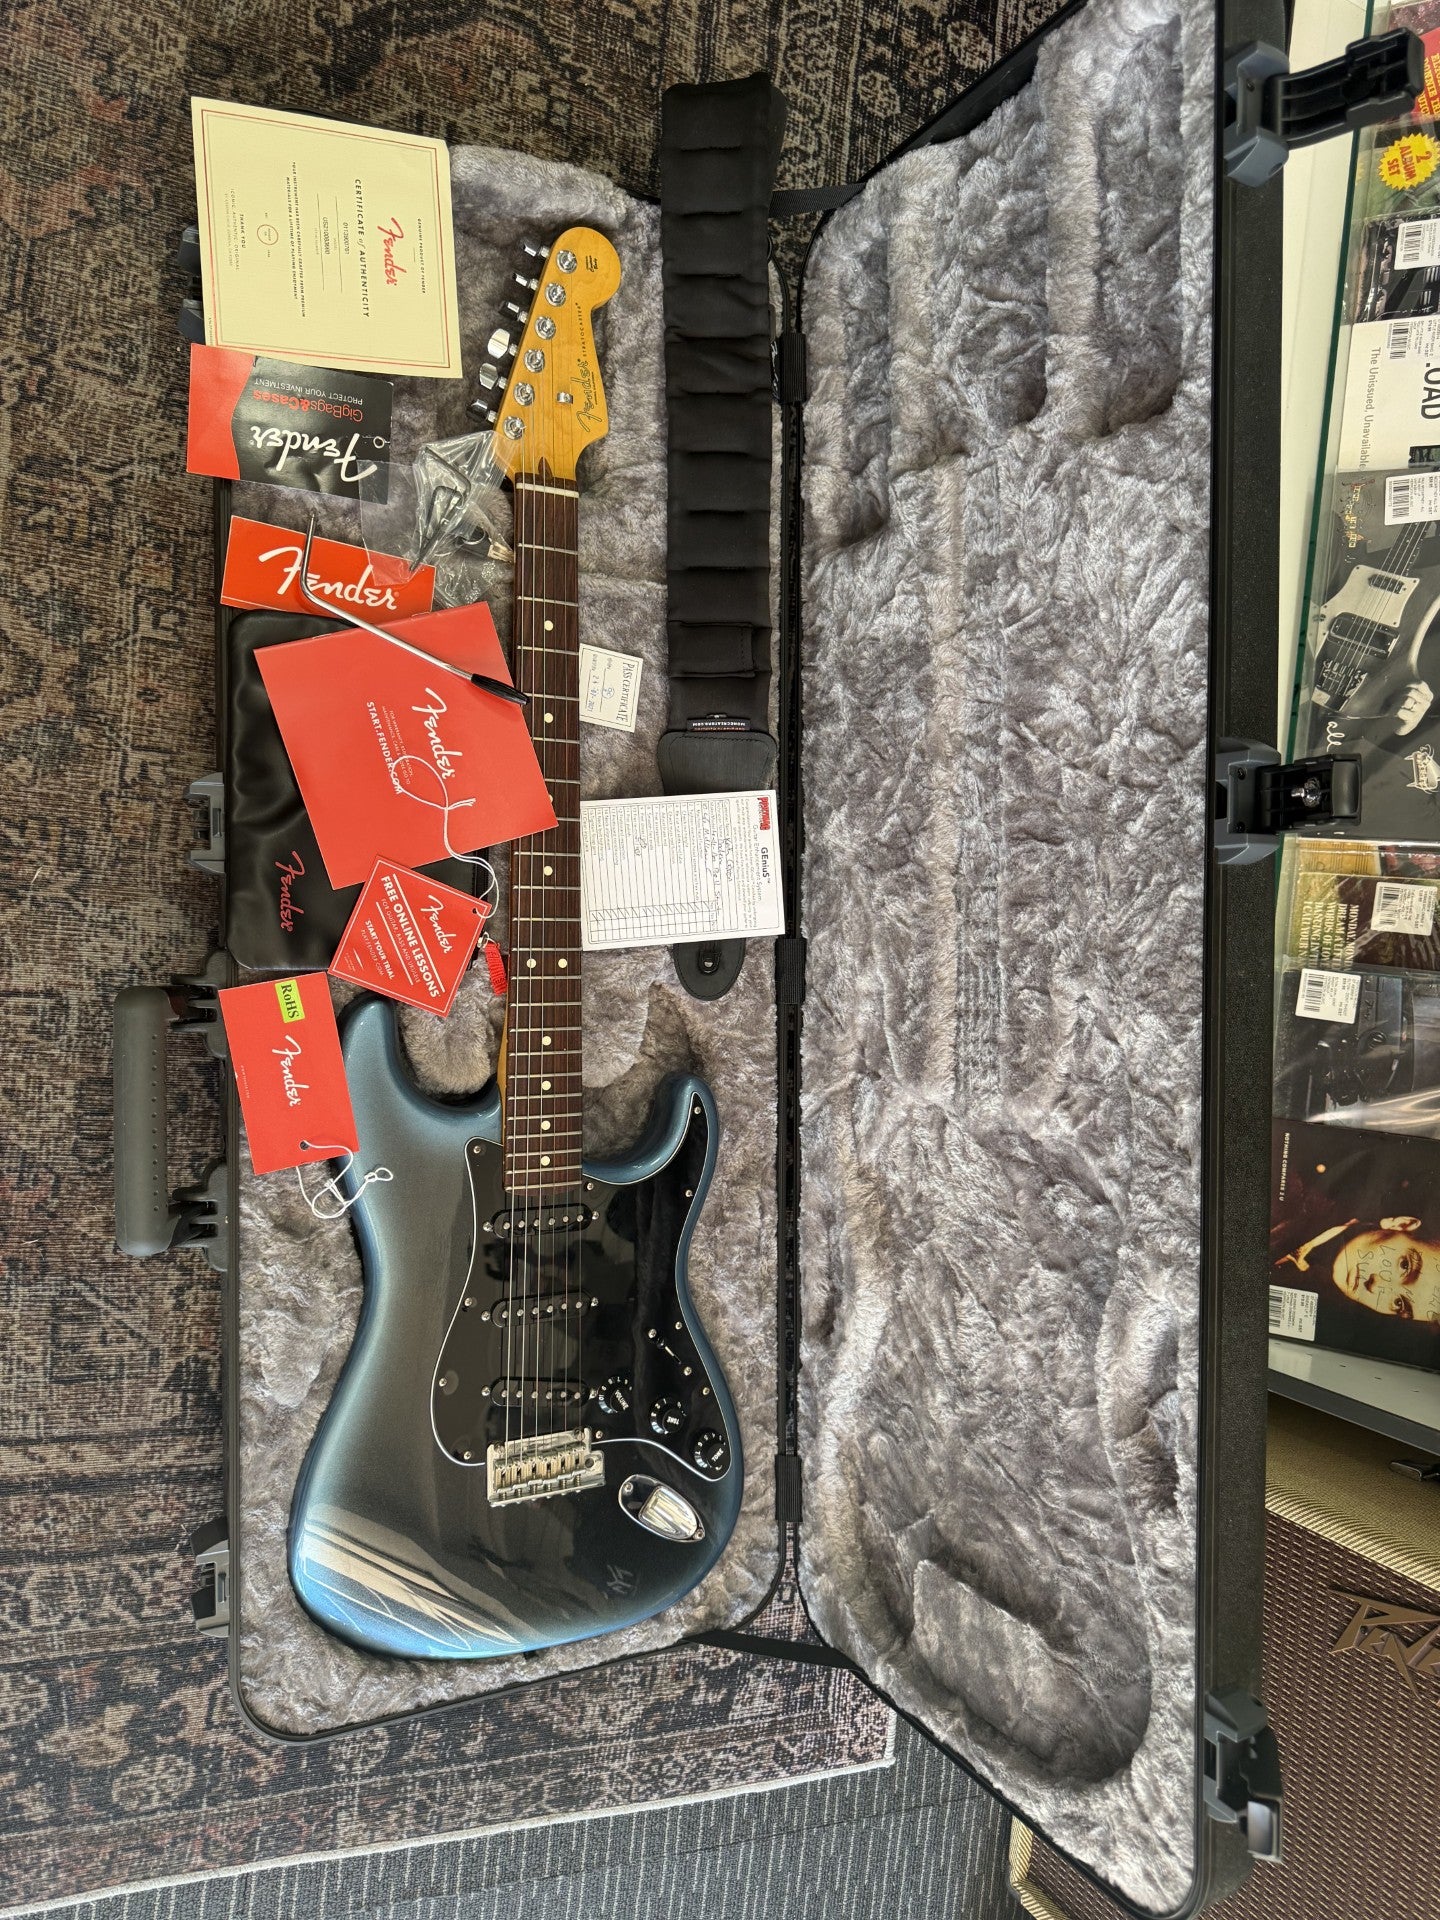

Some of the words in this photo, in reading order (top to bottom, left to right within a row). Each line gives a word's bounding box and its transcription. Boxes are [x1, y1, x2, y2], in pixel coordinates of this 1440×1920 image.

[1386, 158, 1400, 176] SET
[1399, 145, 1416, 180] ALBUM
[1415, 150, 1433, 163] 2
[354, 178, 364, 235] CERTIFICATE
[356, 238, 365, 250] of
[378, 217, 406, 285] Fender
[359, 250, 369, 317] AUTHENTICITY
[1370, 346, 1380, 365] The
[253, 377, 303, 393] INVESTMENT
[303, 386, 327, 398] YOUR
[327, 391, 363, 405] PROTECT
[570, 360, 602, 432] Fender
[1364, 367, 1379, 413] Unissued,
[1421, 362, 1440, 421] OAD
[253, 390, 363, 422] GigBags&Cases
[251, 426, 377, 482] Fender
[1359, 415, 1374, 469] Unavailable
[259, 547, 397, 610] Fender
[367, 701, 402, 794] START.FENDER.COM
[412, 687, 462, 780] Fender
[1326, 721, 1344, 752] all
[275, 850, 305, 929] Fender
[379, 874, 399, 902] FREE
[391, 902, 419, 947] ONLINE
[420, 895, 457, 953] Fender
[1311, 901, 1324, 940] DANCING
[1323, 900, 1336, 933] WORDS
[1335, 903, 1347, 934] DREAM
[379, 898, 389, 910] FOR
[394, 933, 405, 948] BASS
[401, 947, 411, 961] AND
[1299, 926, 1310, 948] YOUR
[1309, 942, 1319, 952] IN
[1322, 934, 1332, 945] OF
[364, 919, 378, 941] START
[373, 940, 387, 961] YOUR
[382, 960, 395, 980] TRIAL
[280, 983, 300, 1019] RoHS
[272, 1035, 310, 1106] Fender
[1279, 1159, 1287, 1190] COMPARES
[614, 1389, 629, 1411] VOLUME
[667, 1416, 680, 1425] TONE
[711, 1448, 724, 1462] TONE
